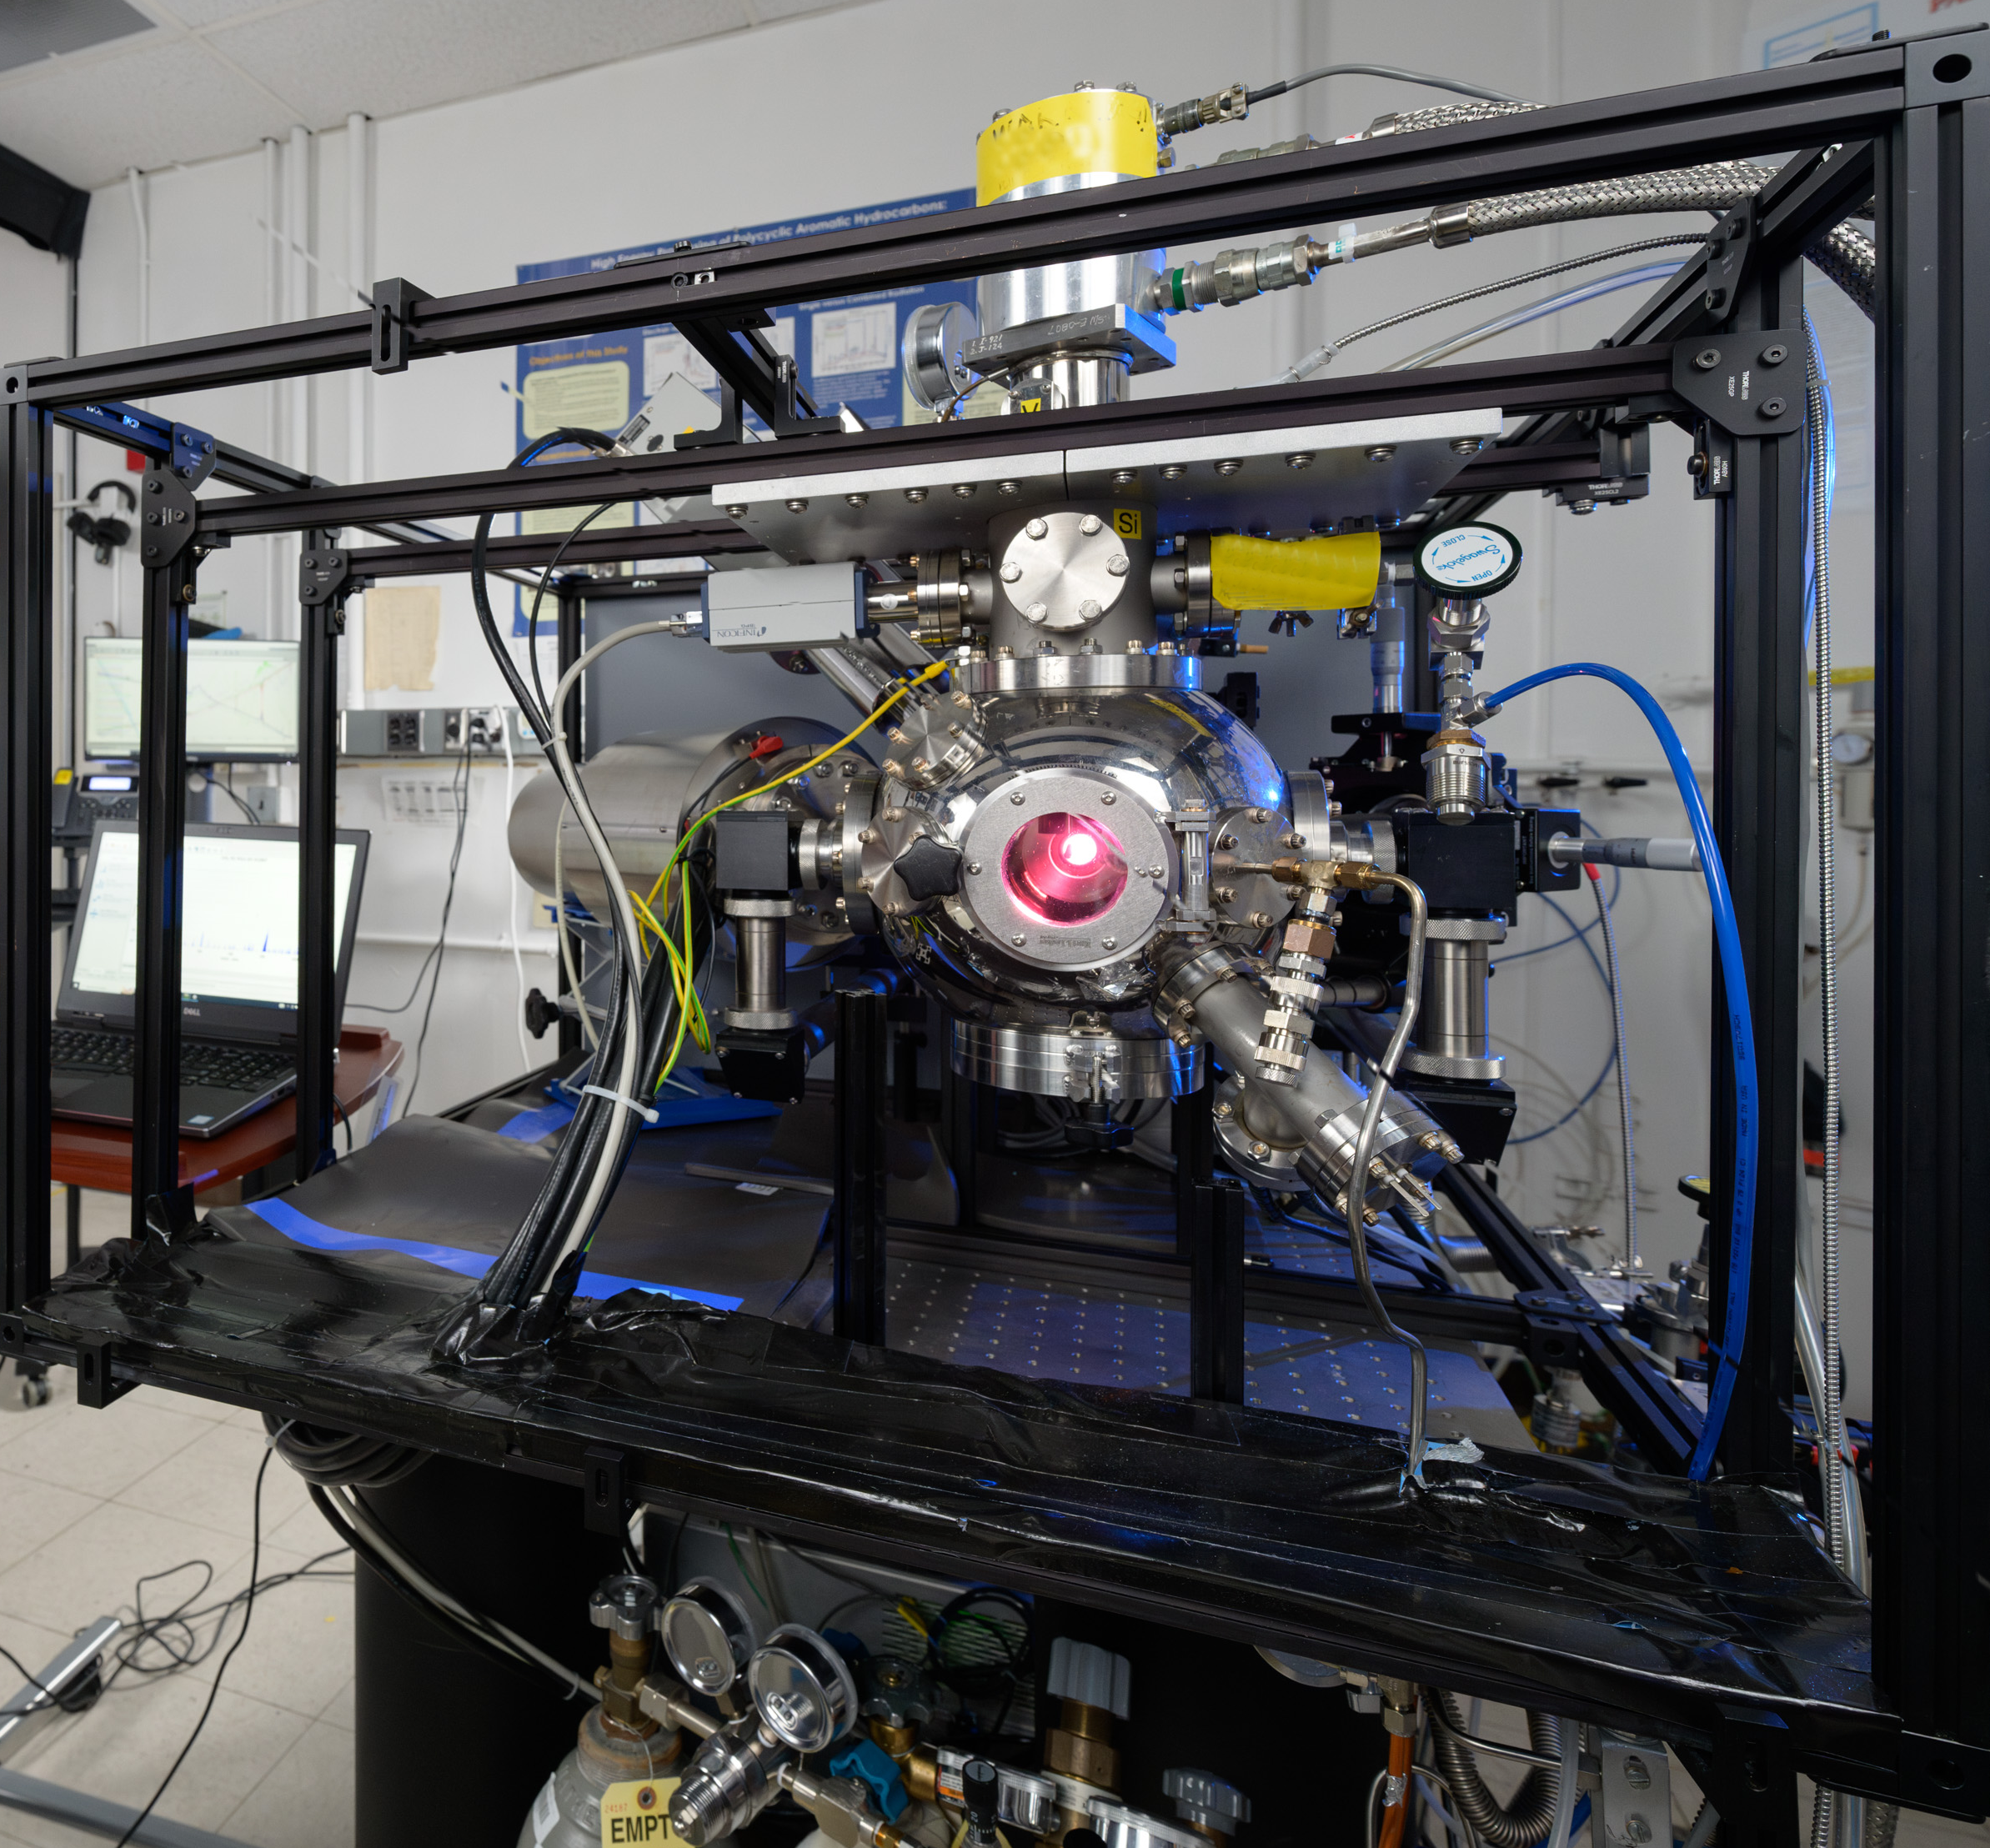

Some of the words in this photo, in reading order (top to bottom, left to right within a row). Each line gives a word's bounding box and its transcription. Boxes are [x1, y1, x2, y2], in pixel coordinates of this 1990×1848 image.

[591, 257, 616, 270] High
[734, 224, 793, 244] Polycyclic
[795, 213, 852, 234] Aromatic
[854, 199, 948, 227] Hydrocarbons:
[1727, 376, 1736, 398] XE25GP
[1741, 370, 1750, 401] THORLABS
[1713, 455, 1722, 485] THORLABS
[1587, 482, 1623, 491] THORLABS
[1119, 512, 1137, 534] Si
[1441, 533, 1466, 548] CLOSE
[1471, 569, 1493, 582] OPEN
[717, 629, 756, 638] INFICON
[183, 1007, 201, 1017] DELL
[1740, 1084, 1749, 1100] USA
[1741, 1104, 1748, 1114] IN
[1740, 1117, 1748, 1136] MADE
[611, 1814, 669, 1844] EMPT
